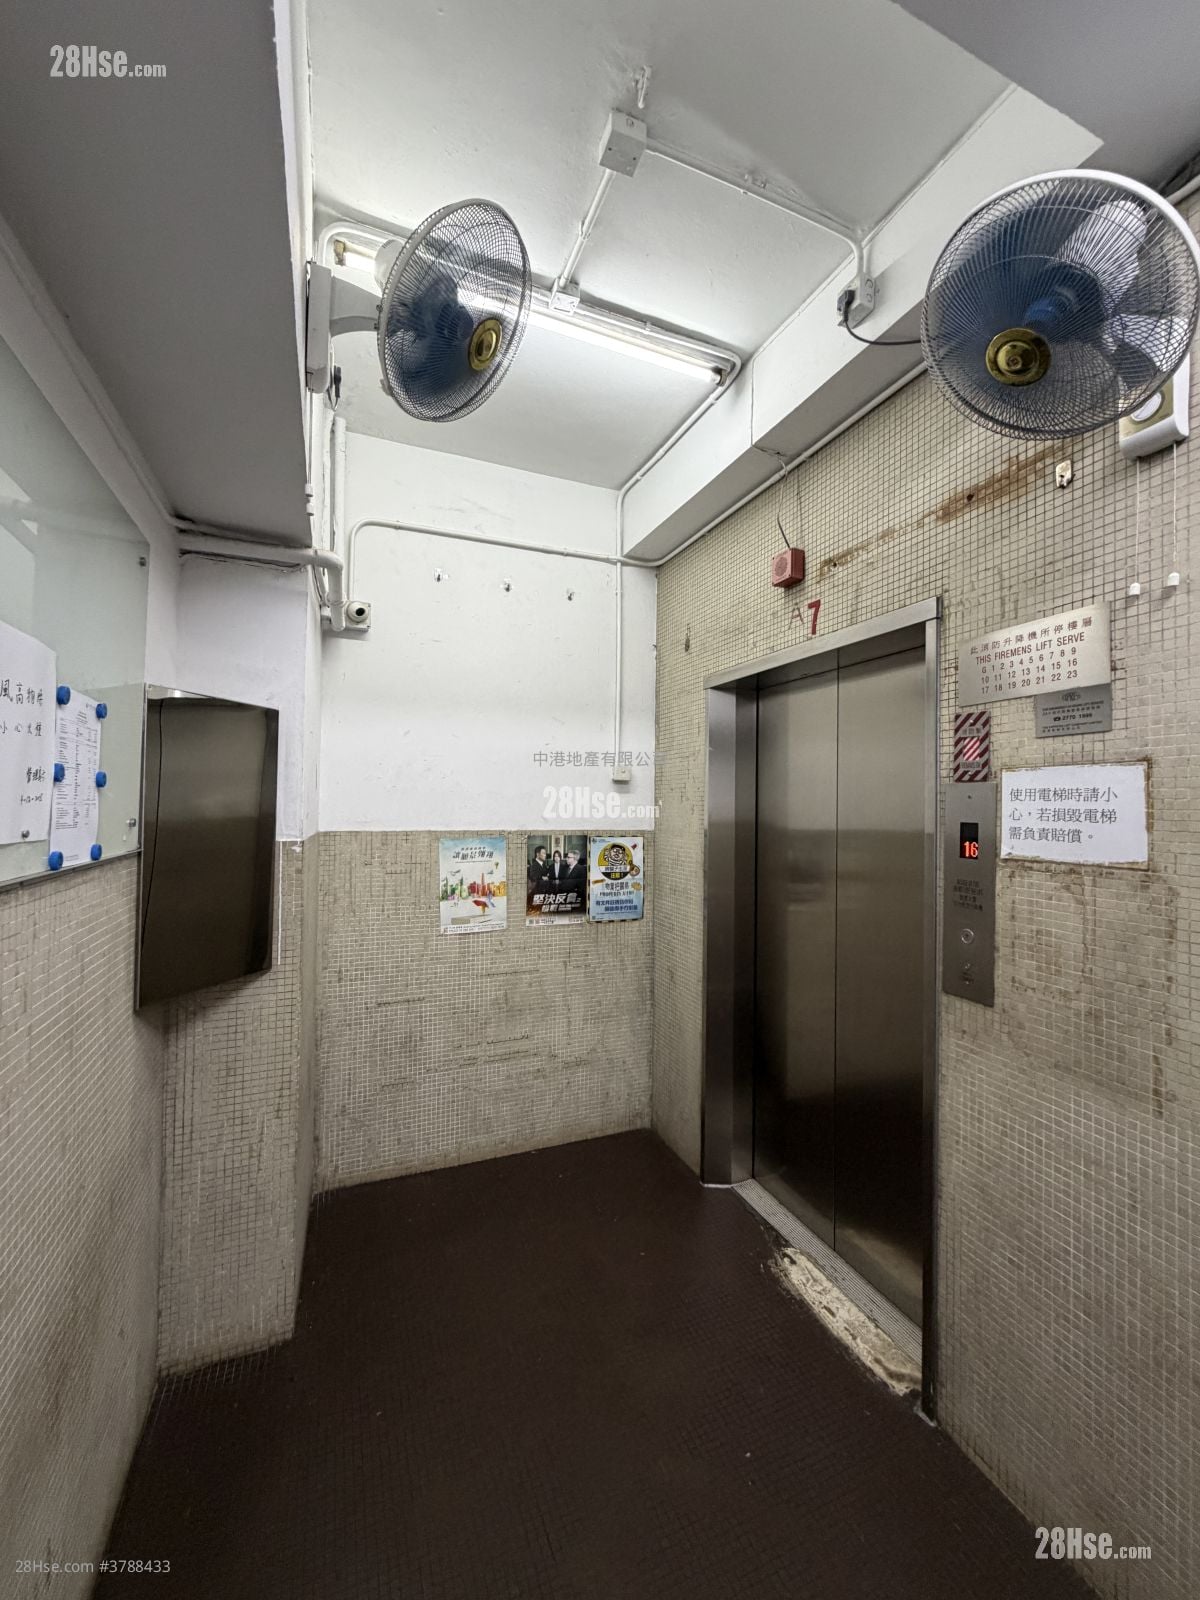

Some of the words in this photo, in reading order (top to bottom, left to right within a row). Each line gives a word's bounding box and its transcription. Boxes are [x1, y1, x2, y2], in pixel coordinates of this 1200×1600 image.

[807, 599, 821, 635] 7
[976, 653, 991, 665] THIS
[994, 645, 1032, 661] FIREMENS
[1036, 640, 1052, 651] LIFT
[1057, 632, 1085, 647] SERVE
[981, 665, 987, 673] G
[1071, 647, 1076, 655] 9
[982, 676, 989, 684] 10
[1008, 671, 1016, 679] 12
[1022, 668, 1031, 676] 13
[1036, 665, 1045, 673] 14
[1051, 662, 1061, 670] 15
[1068, 659, 1078, 667] 16
[982, 686, 989, 694] 17
[995, 684, 1002, 692] 18
[1008, 681, 1016, 689] 19
[1022, 679, 1031, 687] 20
[1036, 676, 1045, 684] 21
[1051, 673, 1061, 682] 22
[1067, 670, 1078, 679] 23
[1009, 786, 1118, 803] 使用電梯時請小
[1008, 807, 1118, 824] 心，若損毀電梯
[1008, 826, 1094, 844] 需負責賠償。
[963, 841, 979, 858] 16
